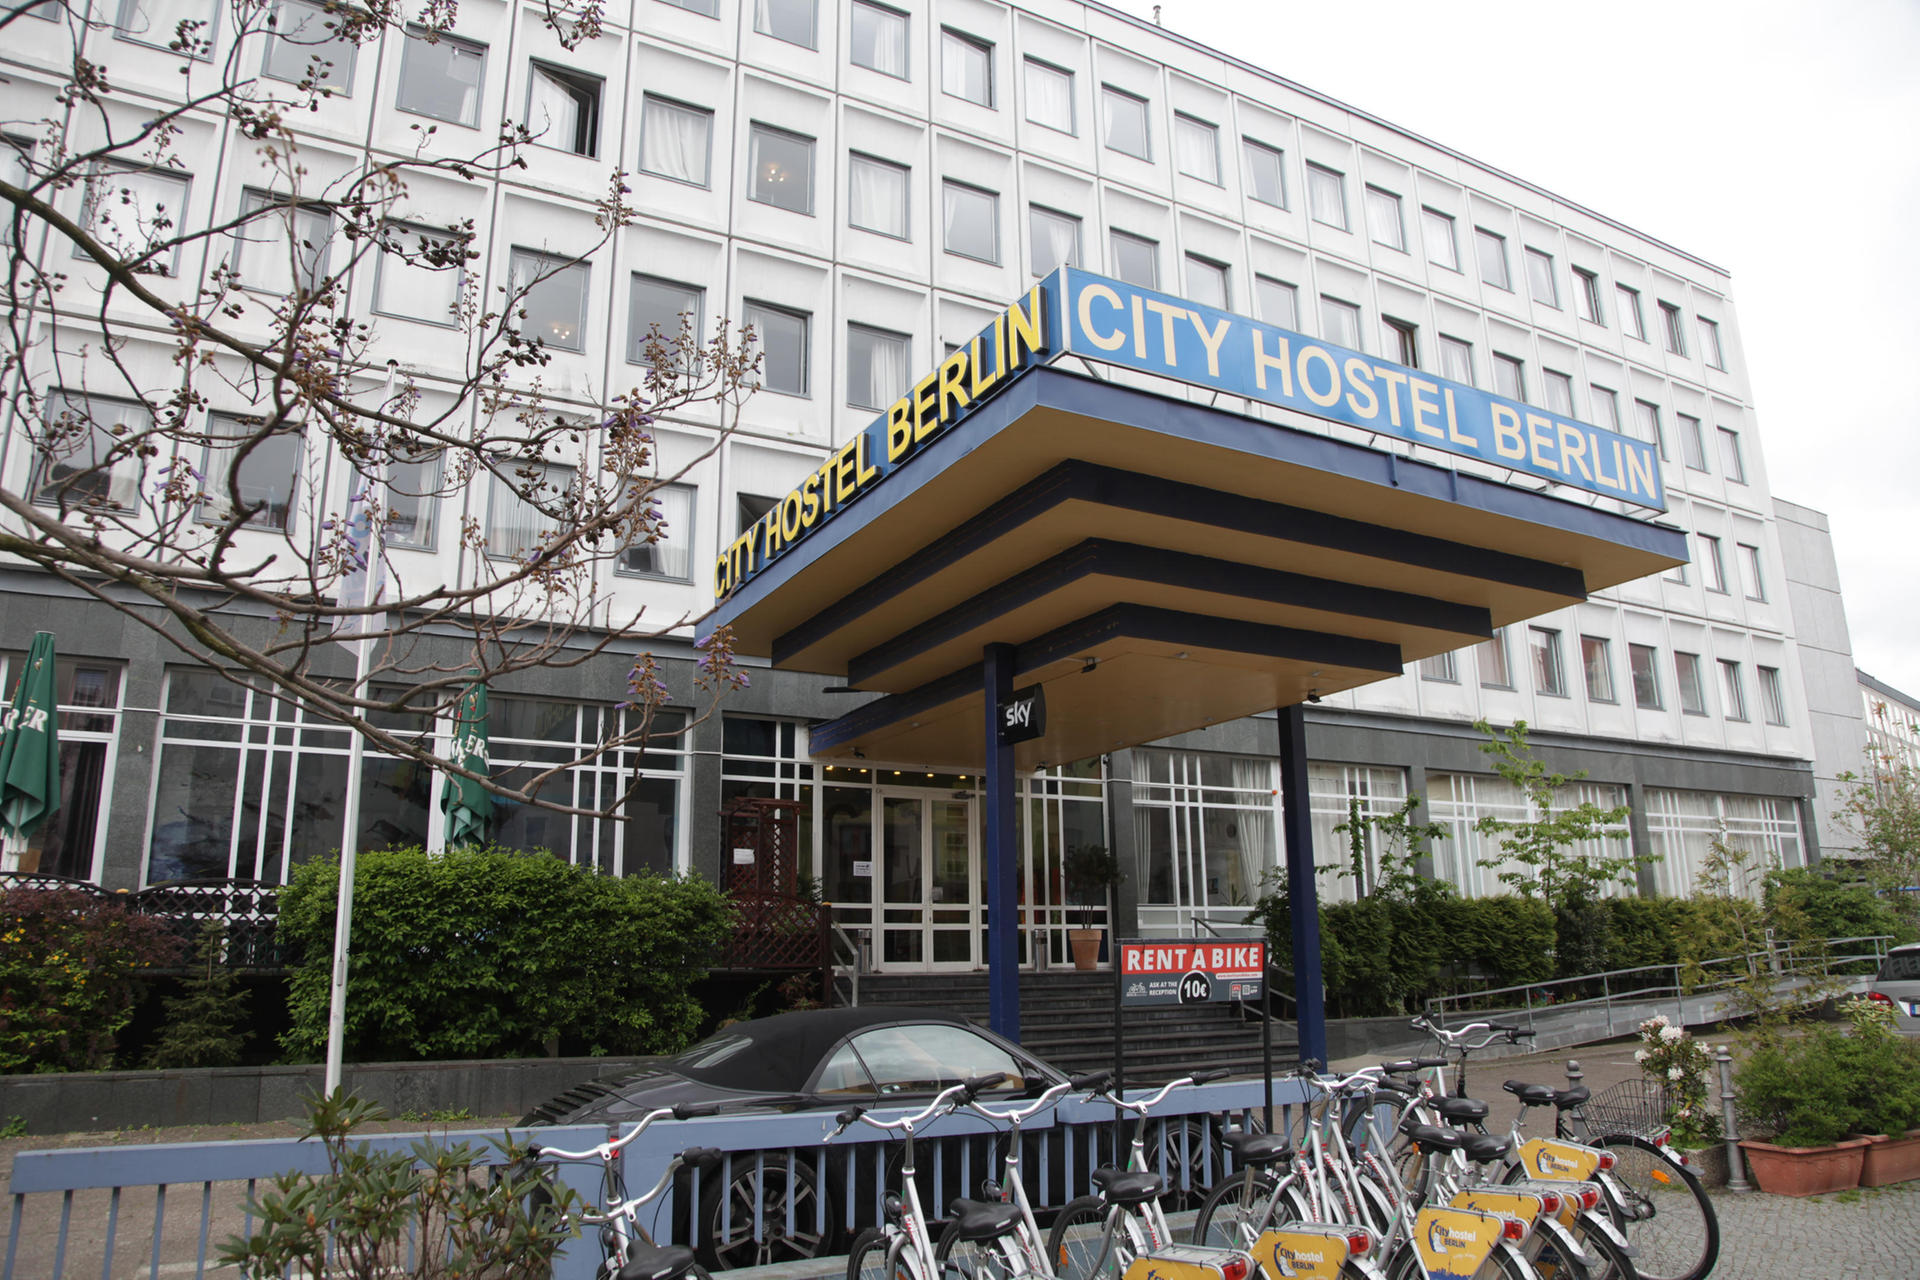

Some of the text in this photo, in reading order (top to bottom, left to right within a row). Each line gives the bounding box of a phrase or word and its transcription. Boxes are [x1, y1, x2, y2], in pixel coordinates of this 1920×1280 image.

[1078, 284, 1657, 499] CITY HOSTEL BERLIN
[714, 285, 1042, 598] CITY HOSTEL BERLIN
[1006, 701, 1031, 727] sky
[1127, 947, 1259, 971] RENT A BIKE
[1184, 980, 1206, 998] 10€
[1444, 1238, 1466, 1248] BERLIN
[1292, 1261, 1315, 1271] BERLIN
